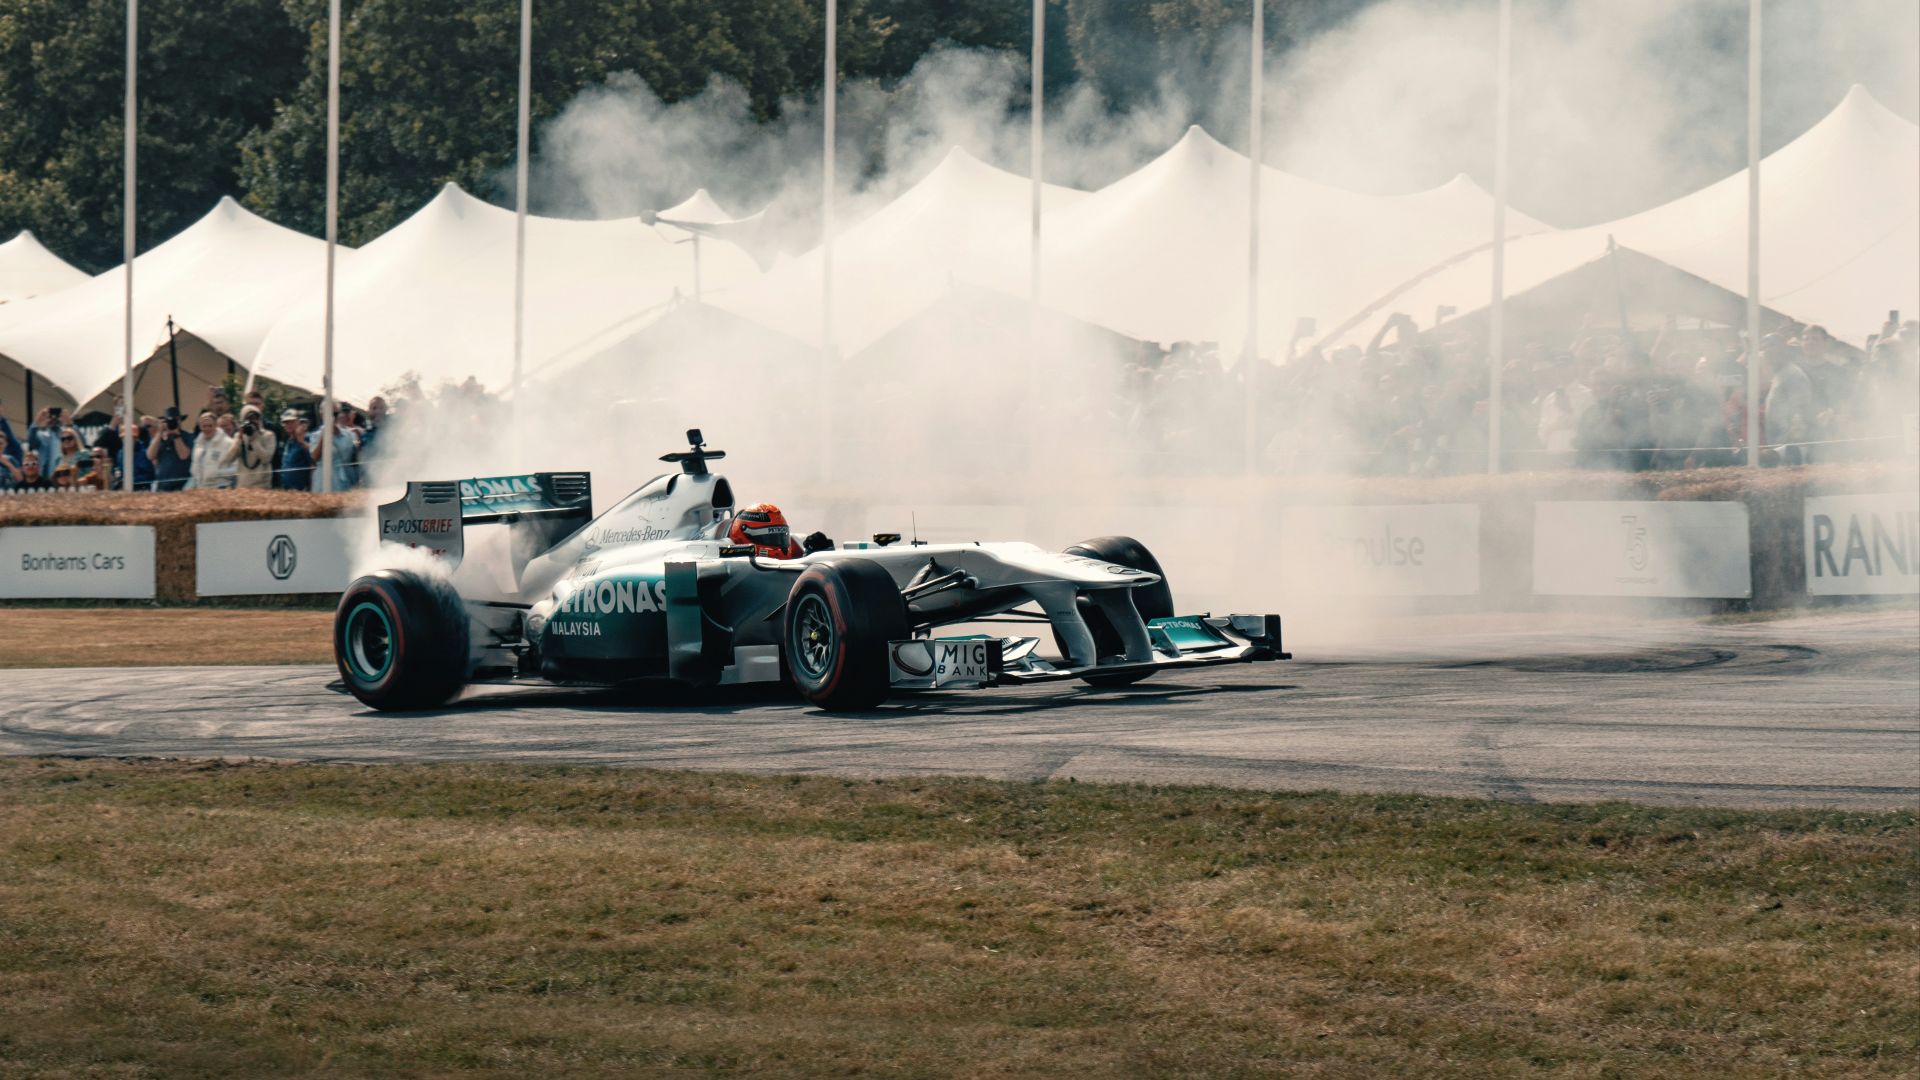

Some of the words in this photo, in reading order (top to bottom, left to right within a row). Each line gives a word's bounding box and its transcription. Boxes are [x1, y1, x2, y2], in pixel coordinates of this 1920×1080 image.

[461, 476, 543, 506] RONAS
[601, 525, 671, 544] Mercedes-Benz
[21, 552, 87, 571] Bonhams
[92, 553, 125, 570] Cars
[561, 579, 667, 614] ETRONAS
[551, 621, 601, 636] MALAYSIA
[941, 644, 985, 665] MIG
[936, 662, 989, 676] BANK
